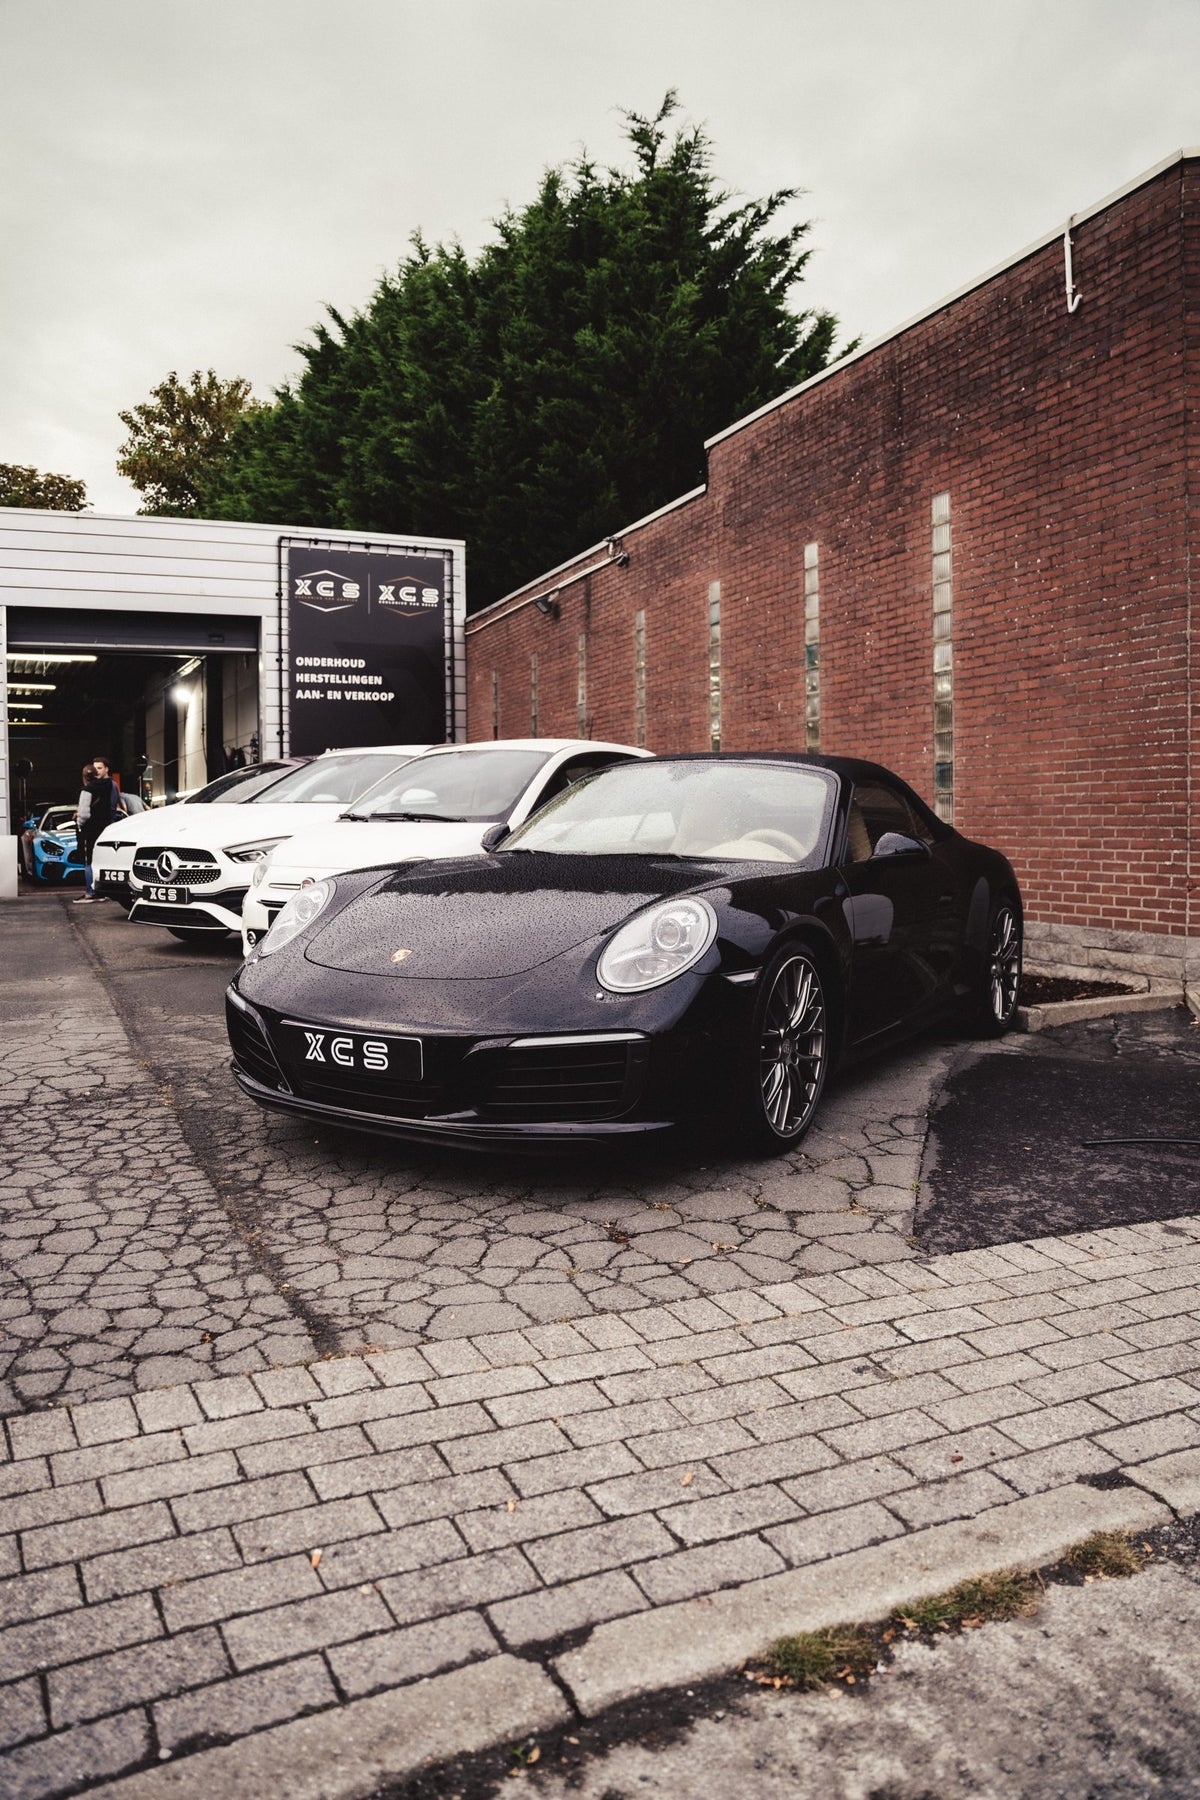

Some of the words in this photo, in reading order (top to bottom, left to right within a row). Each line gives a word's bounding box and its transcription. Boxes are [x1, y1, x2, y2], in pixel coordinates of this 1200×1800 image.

[294, 579, 360, 598] XCS
[378, 585, 439, 603] XCS
[295, 657, 366, 668] ONDERHOUD
[295, 674, 383, 685] HERSTELLINGEN
[295, 690, 324, 699] AAN-
[327, 691, 342, 700] EN
[344, 691, 395, 702] VERKOOP
[104, 871, 125, 881] XCS
[149, 888, 177, 901] XCS
[304, 1032, 389, 1070] XCS
